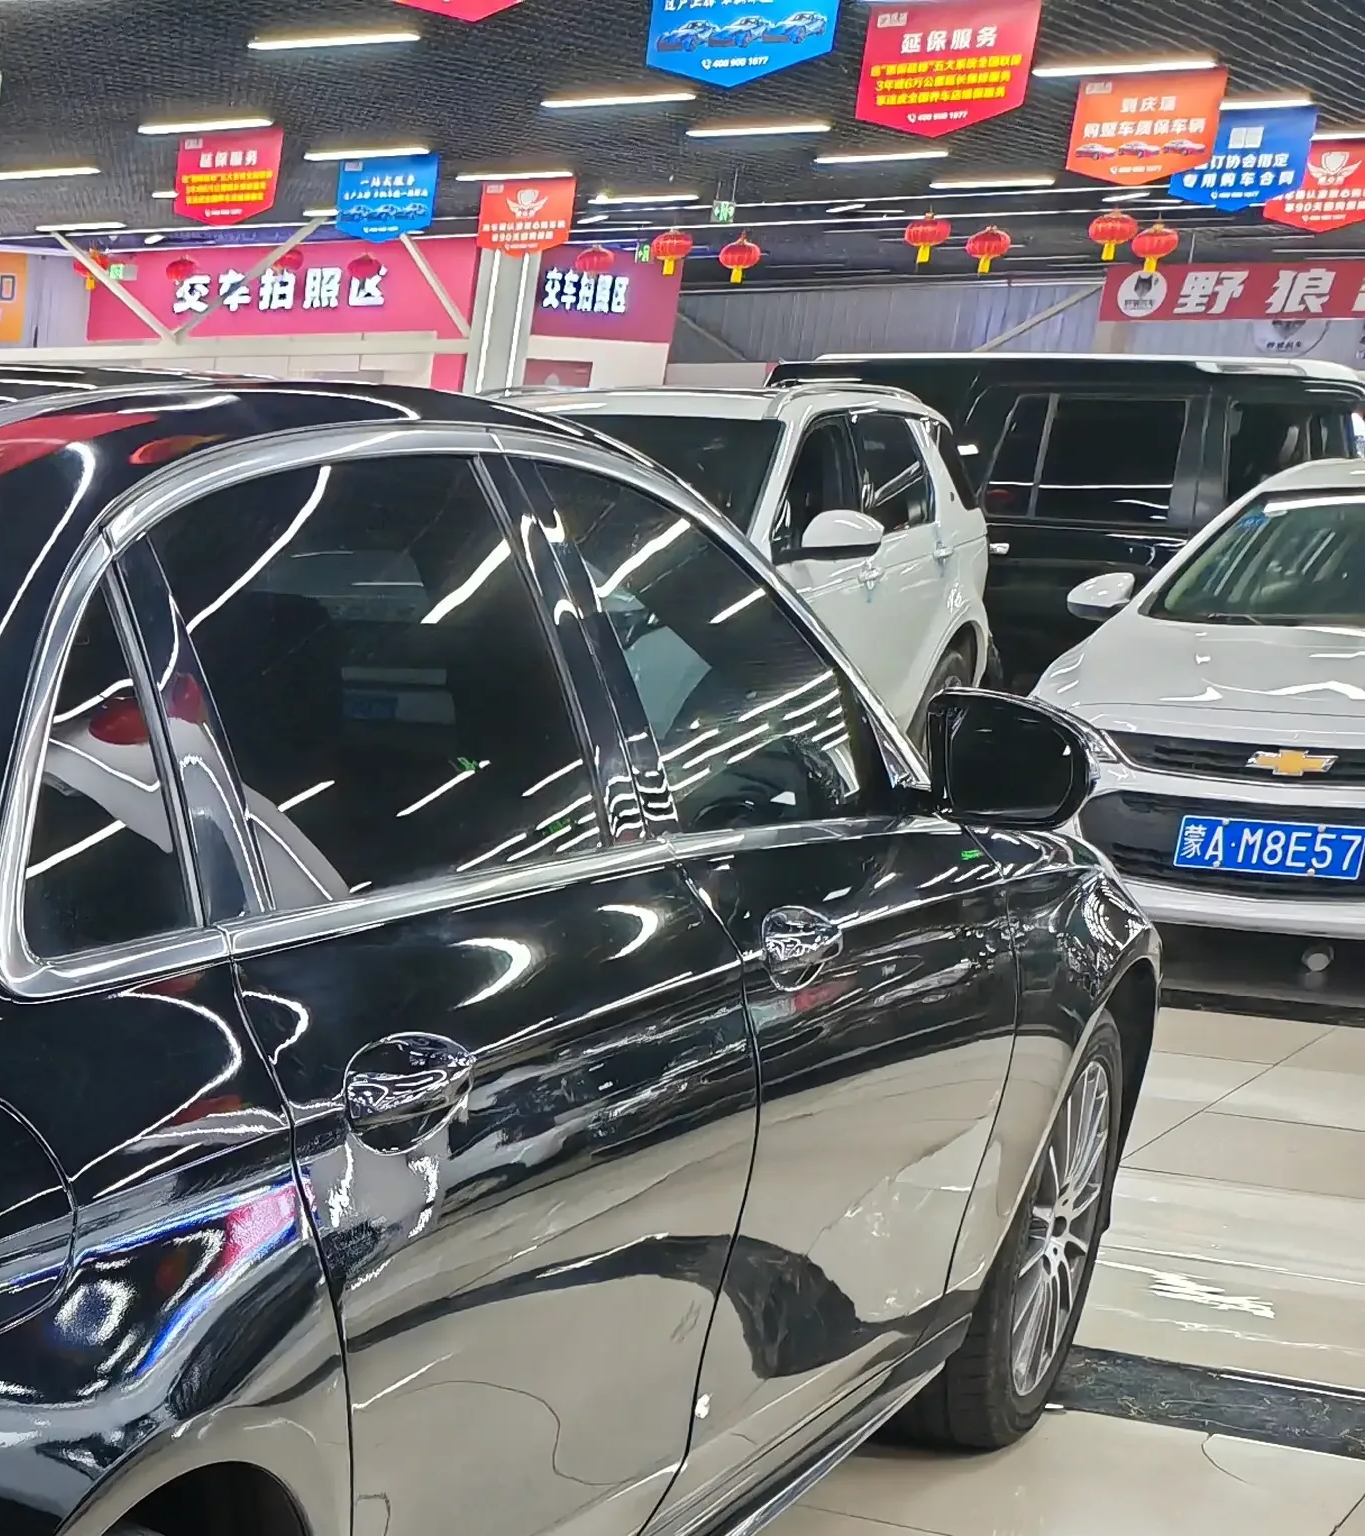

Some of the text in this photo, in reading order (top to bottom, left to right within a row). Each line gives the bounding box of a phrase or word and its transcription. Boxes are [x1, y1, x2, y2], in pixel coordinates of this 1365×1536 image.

[901, 25, 998, 53] 延保服务
[1183, 170, 1295, 188] 专用购车合同
[174, 265, 387, 313] 交车拍照区
[542, 266, 629, 313] 交车拍照区
[1172, 268, 1365, 314] 野狼
